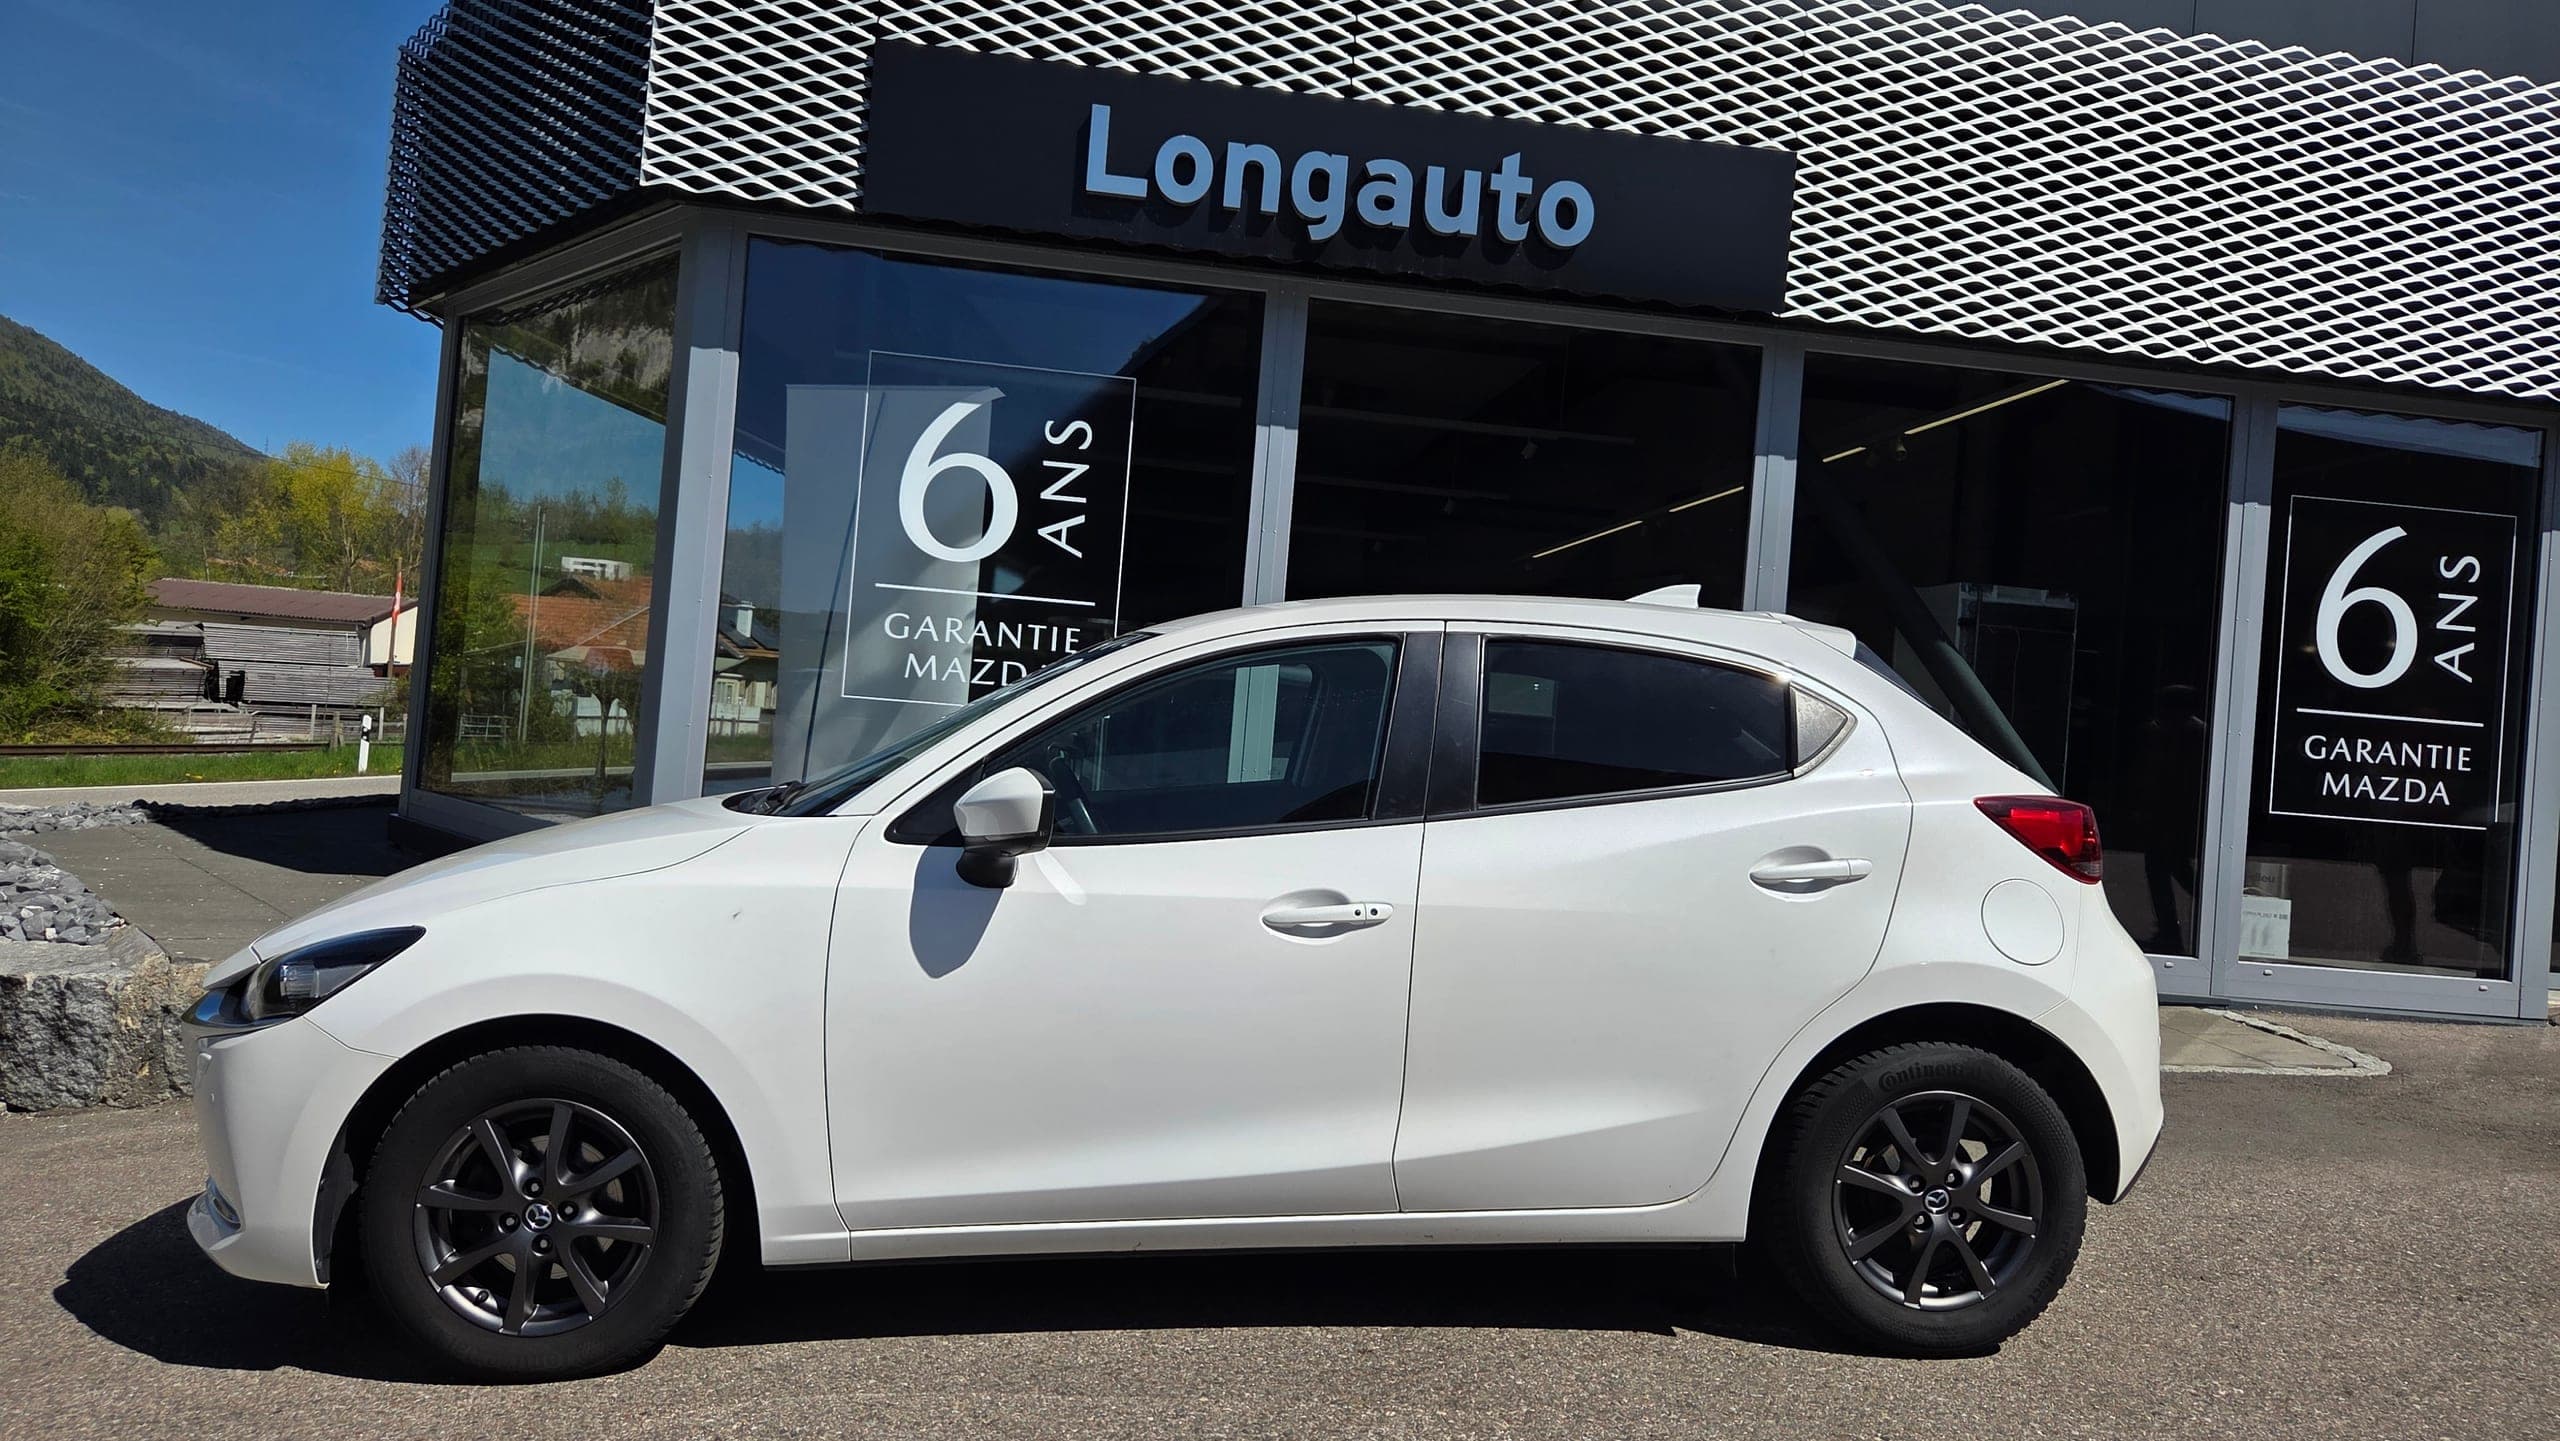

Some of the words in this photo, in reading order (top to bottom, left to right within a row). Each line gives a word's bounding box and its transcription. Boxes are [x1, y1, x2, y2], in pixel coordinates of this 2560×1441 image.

[1085, 104, 1596, 249] Longauto
[898, 386, 1019, 563] 6
[1037, 420, 1093, 559] ANS
[2316, 525, 2418, 689] 6
[2434, 555, 2481, 683] ANS
[884, 612, 1081, 654] GARANTIE
[904, 653, 1046, 687] MAZD
[2304, 734, 2472, 772] GARANTIE
[2322, 771, 2450, 806] MAZDA
